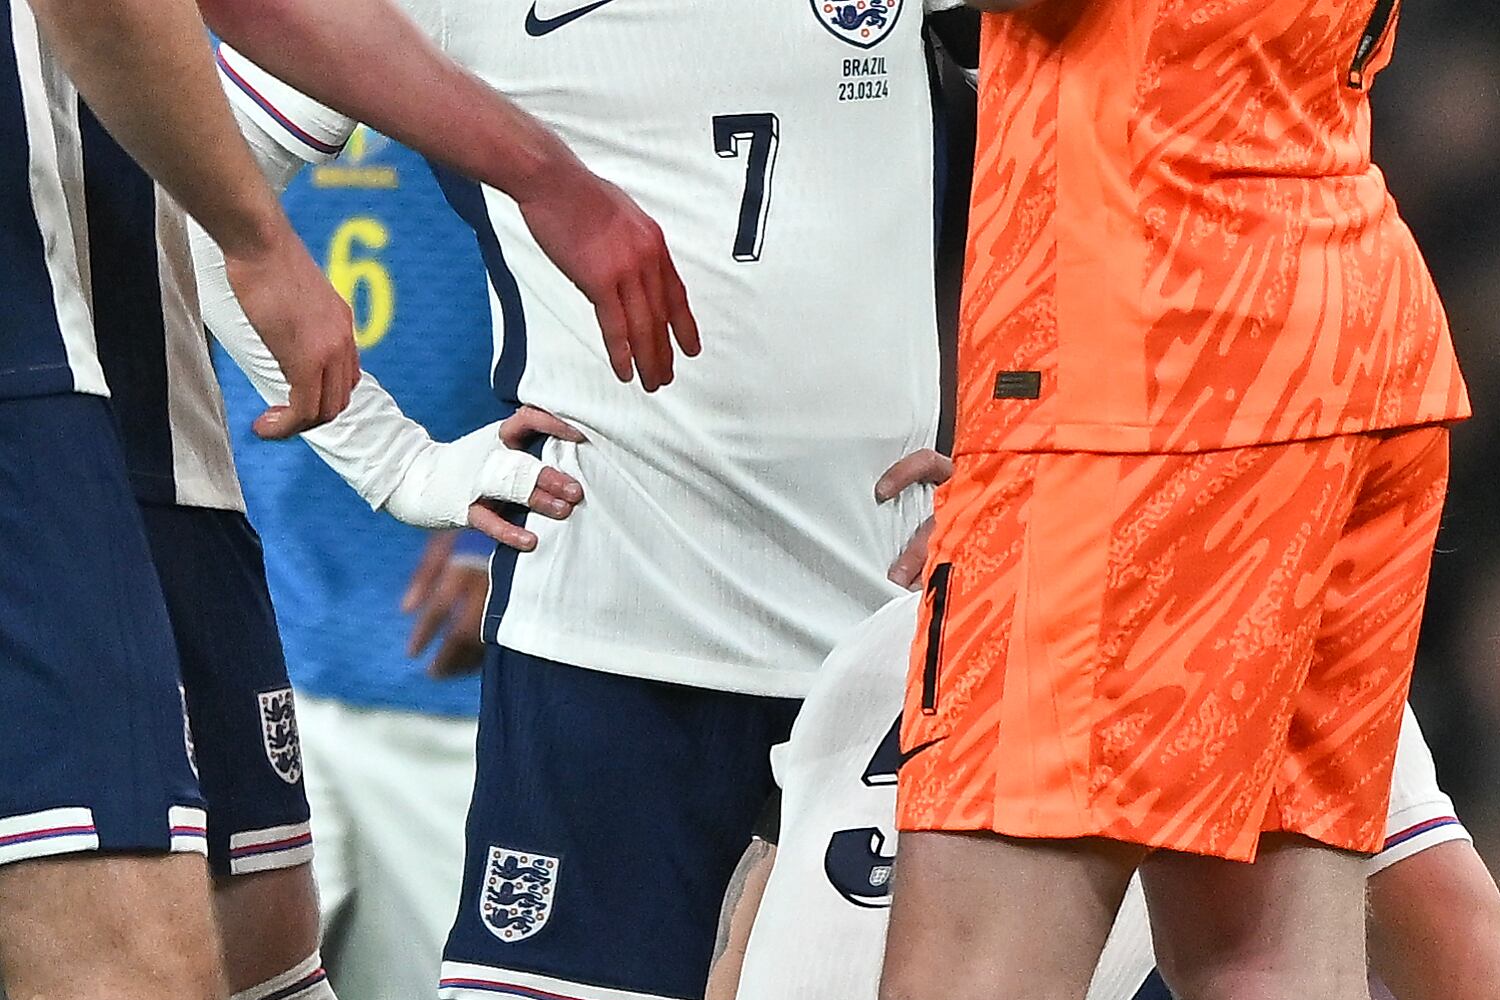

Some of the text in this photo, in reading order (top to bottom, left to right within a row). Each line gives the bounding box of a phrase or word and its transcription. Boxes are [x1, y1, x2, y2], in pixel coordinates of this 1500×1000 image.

[838, 79, 888, 101] 23.03.24
[843, 57, 887, 77] BRAZIL
[712, 113, 780, 262] 7
[327, 217, 395, 349] 6
[921, 562, 955, 716] 1
